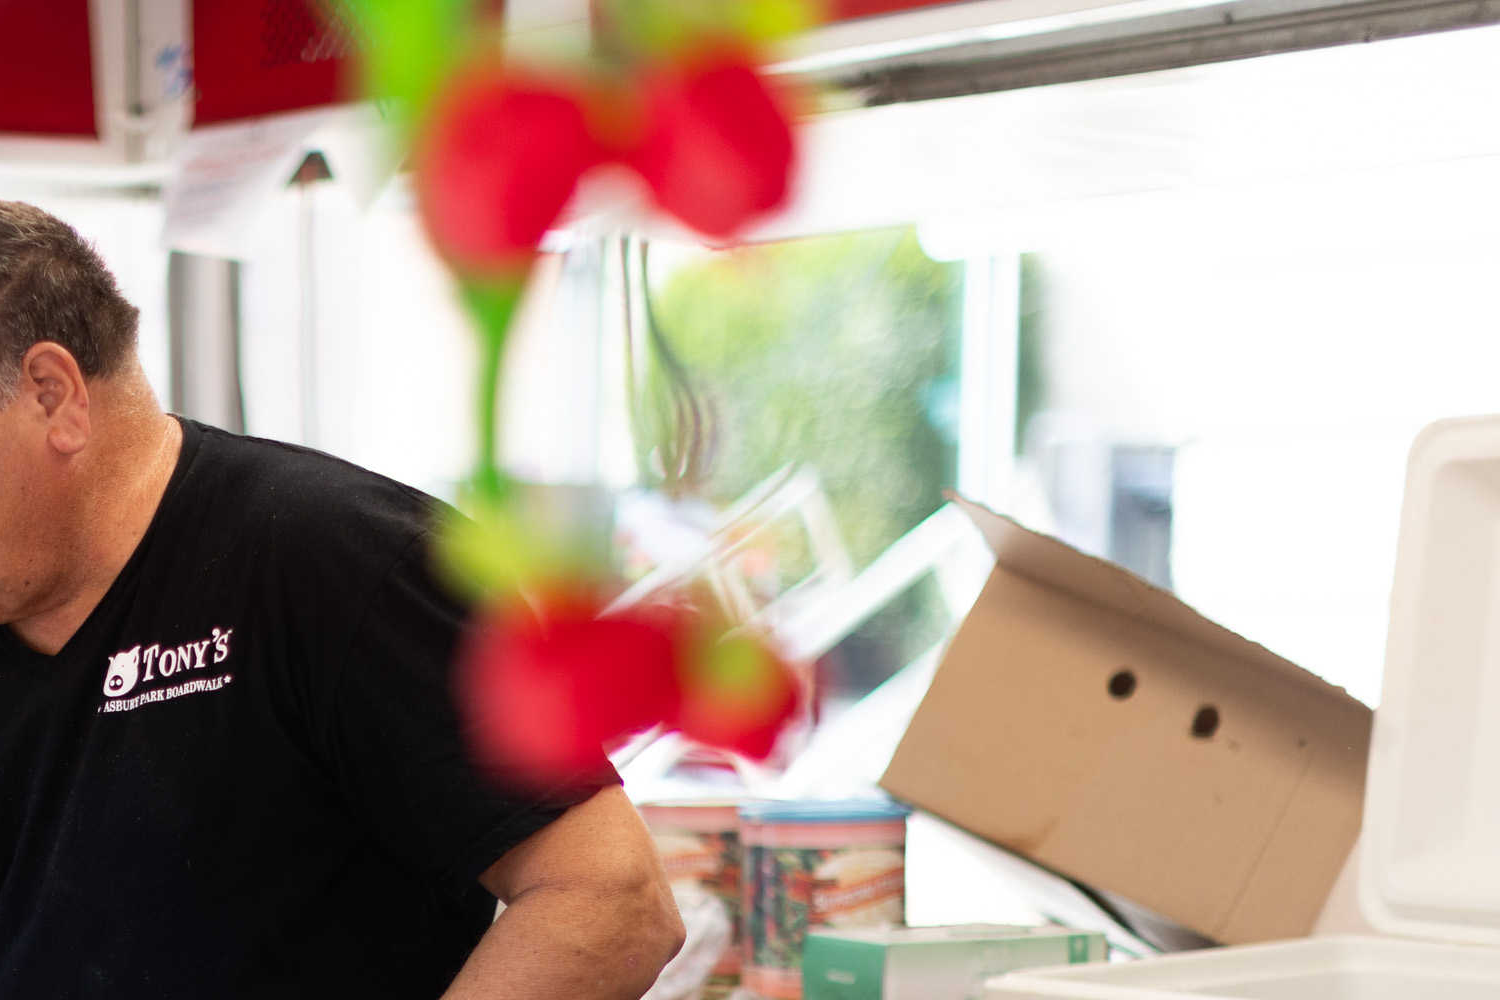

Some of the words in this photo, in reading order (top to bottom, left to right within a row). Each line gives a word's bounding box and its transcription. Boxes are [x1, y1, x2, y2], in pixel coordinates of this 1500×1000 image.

[143, 628, 232, 682] TONY'S
[103, 697, 140, 712] ASBURY
[139, 690, 164, 705] PARK
[165, 676, 223, 700] BOARDWALK
